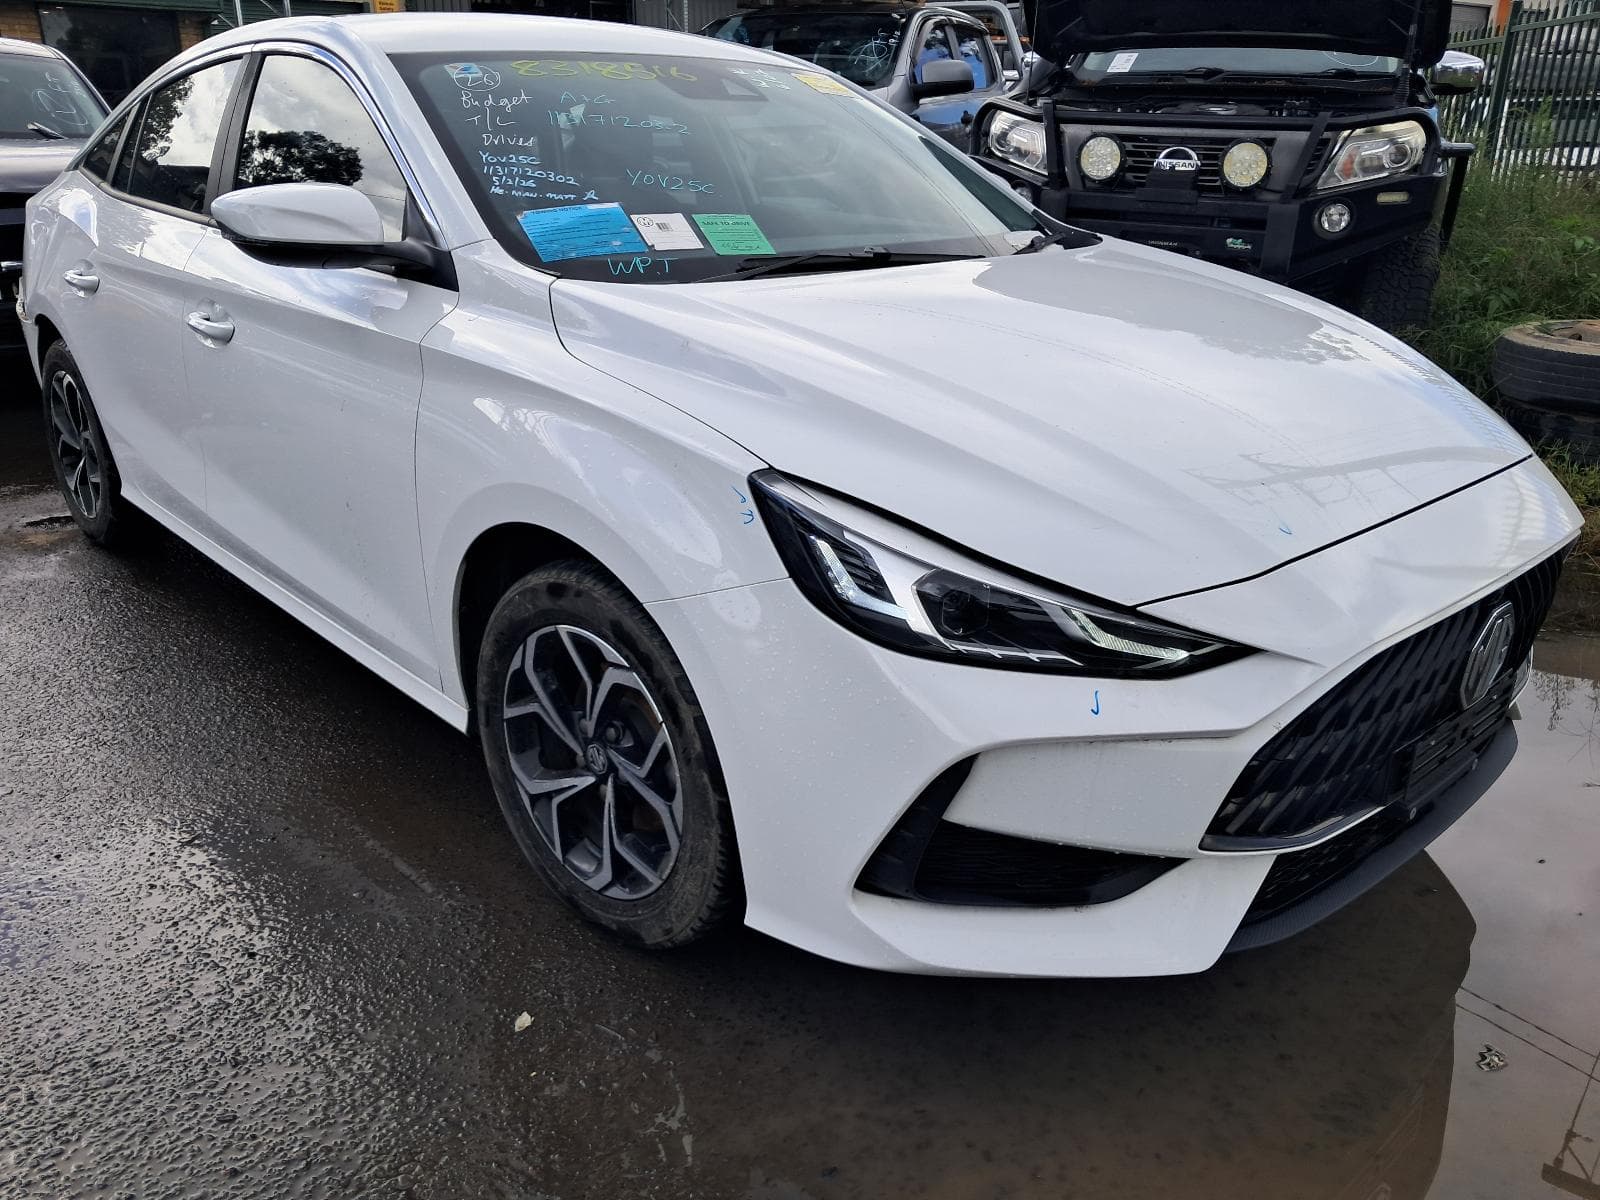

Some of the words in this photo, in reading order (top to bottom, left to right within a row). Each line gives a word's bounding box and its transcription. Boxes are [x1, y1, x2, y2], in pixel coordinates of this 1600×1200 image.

[461, 89, 533, 112] Budget
[1156, 160, 1196, 170] NISSAN
[483, 166, 580, 186] 11317120302
[492, 176, 537, 188] 5/2/26
[626, 168, 715, 194] YOV25C
